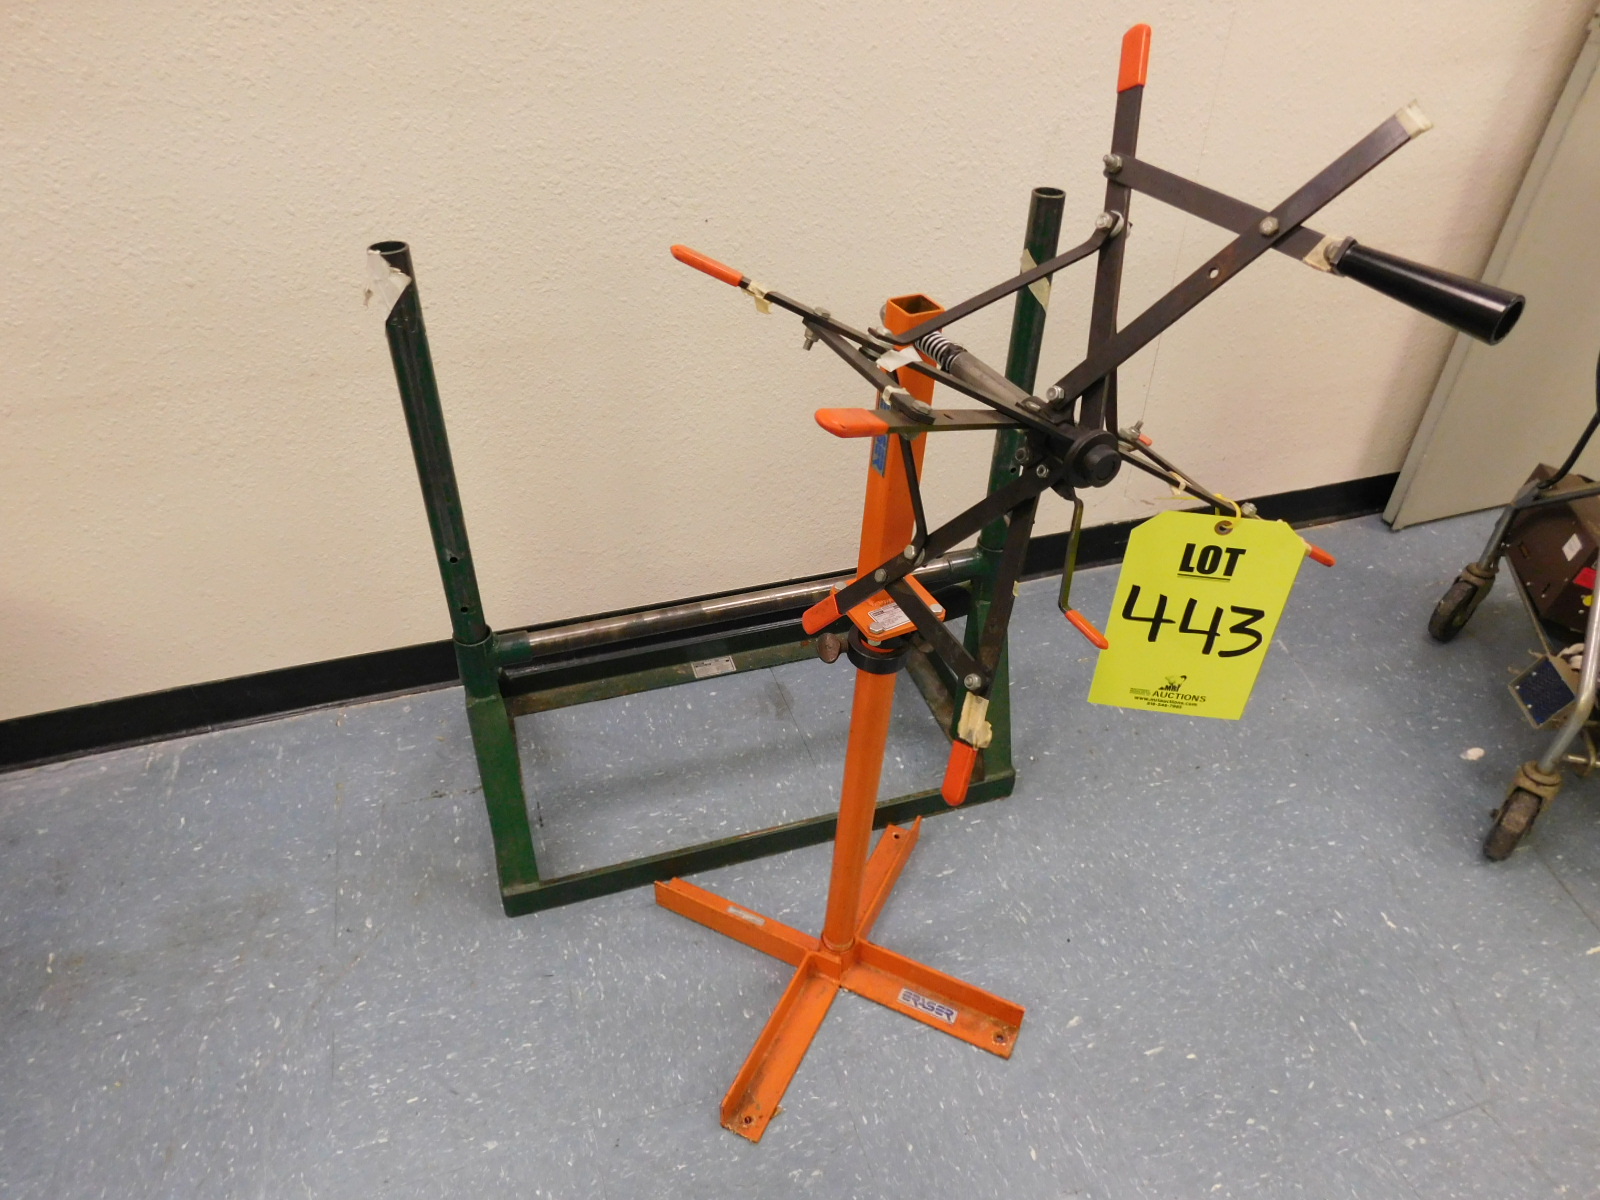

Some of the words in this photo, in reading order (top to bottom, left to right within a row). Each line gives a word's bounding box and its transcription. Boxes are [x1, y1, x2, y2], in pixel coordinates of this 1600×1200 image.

[1179, 543, 1247, 577] LOT
[1122, 584, 1265, 658] 443
[1152, 690, 1207, 703] AUCTIONS
[902, 990, 954, 1022] ERASER
